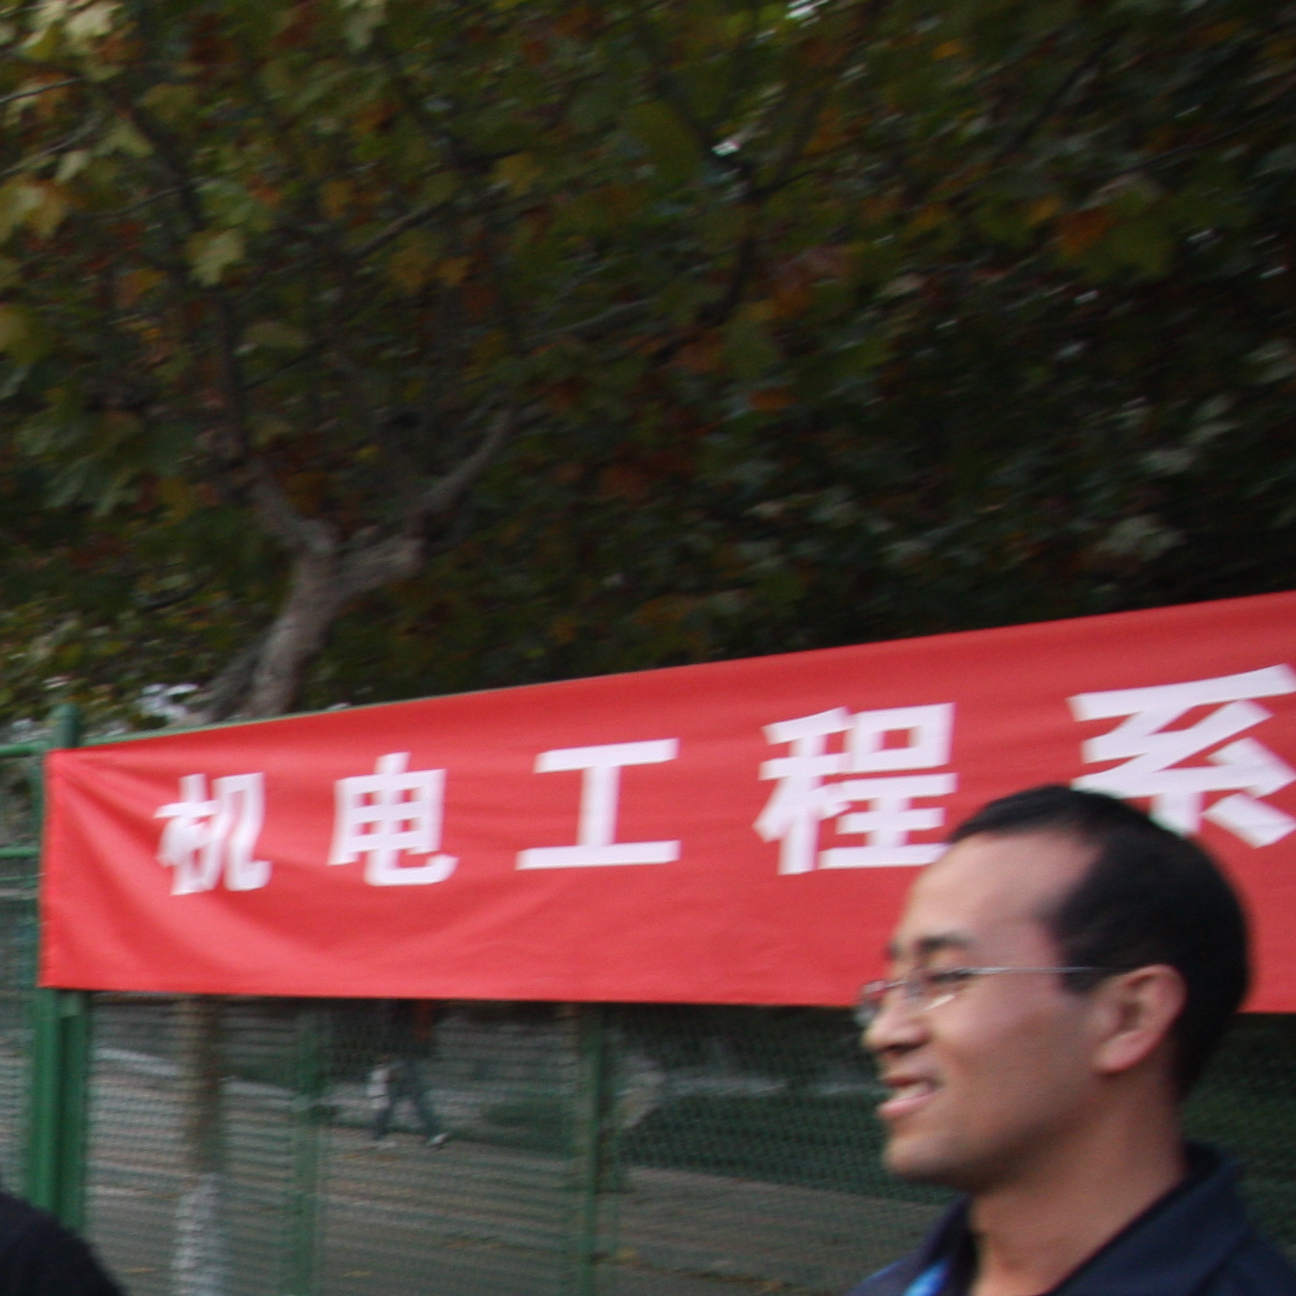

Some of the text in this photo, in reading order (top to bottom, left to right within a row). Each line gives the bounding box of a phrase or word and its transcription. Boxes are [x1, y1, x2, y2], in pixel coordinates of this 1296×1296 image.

[153, 663, 1296, 896] 机电工程系
